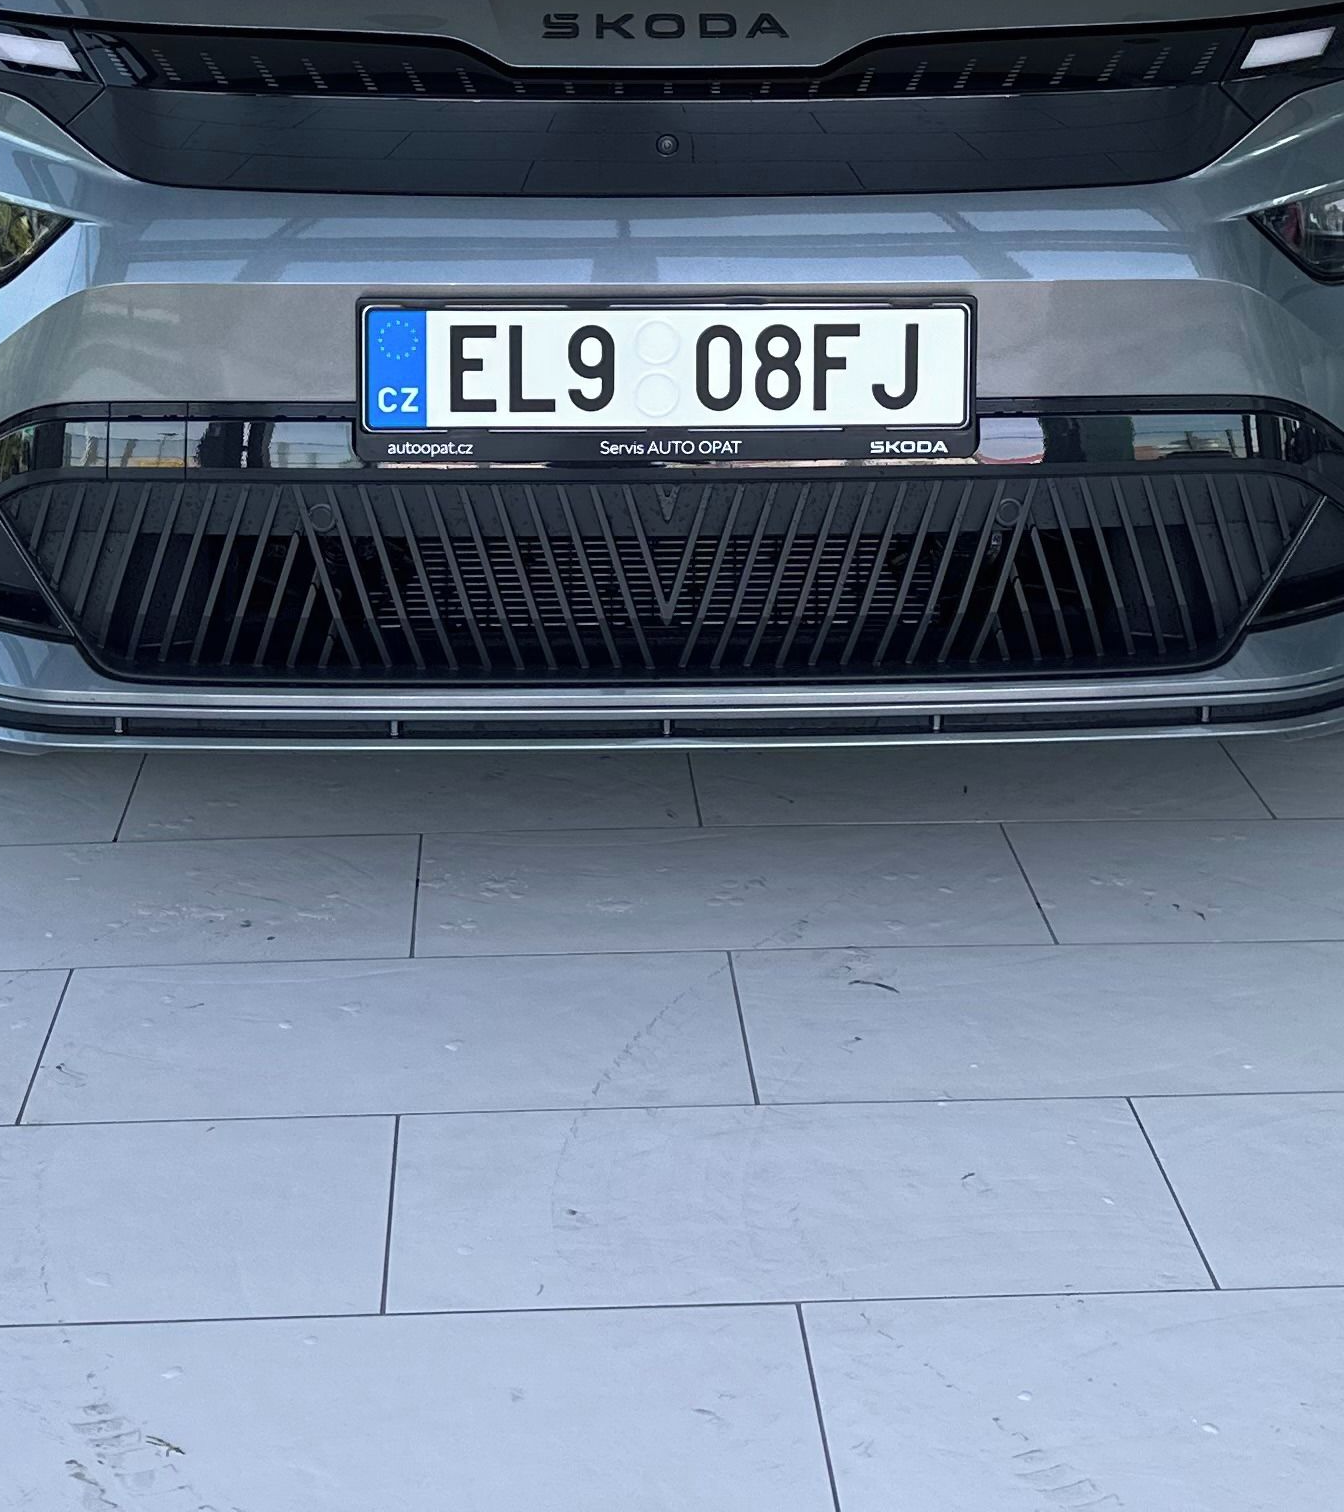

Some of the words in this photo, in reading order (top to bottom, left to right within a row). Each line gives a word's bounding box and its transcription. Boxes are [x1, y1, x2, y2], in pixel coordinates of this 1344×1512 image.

[450, 323, 615, 413] EL9
[695, 321, 919, 412] 08FJ
[377, 386, 419, 414] CZ
[387, 441, 474, 458] autoopat.cz
[599, 441, 644, 456] Servis
[647, 441, 695, 456] AUTO
[698, 441, 743, 456] OPAT
